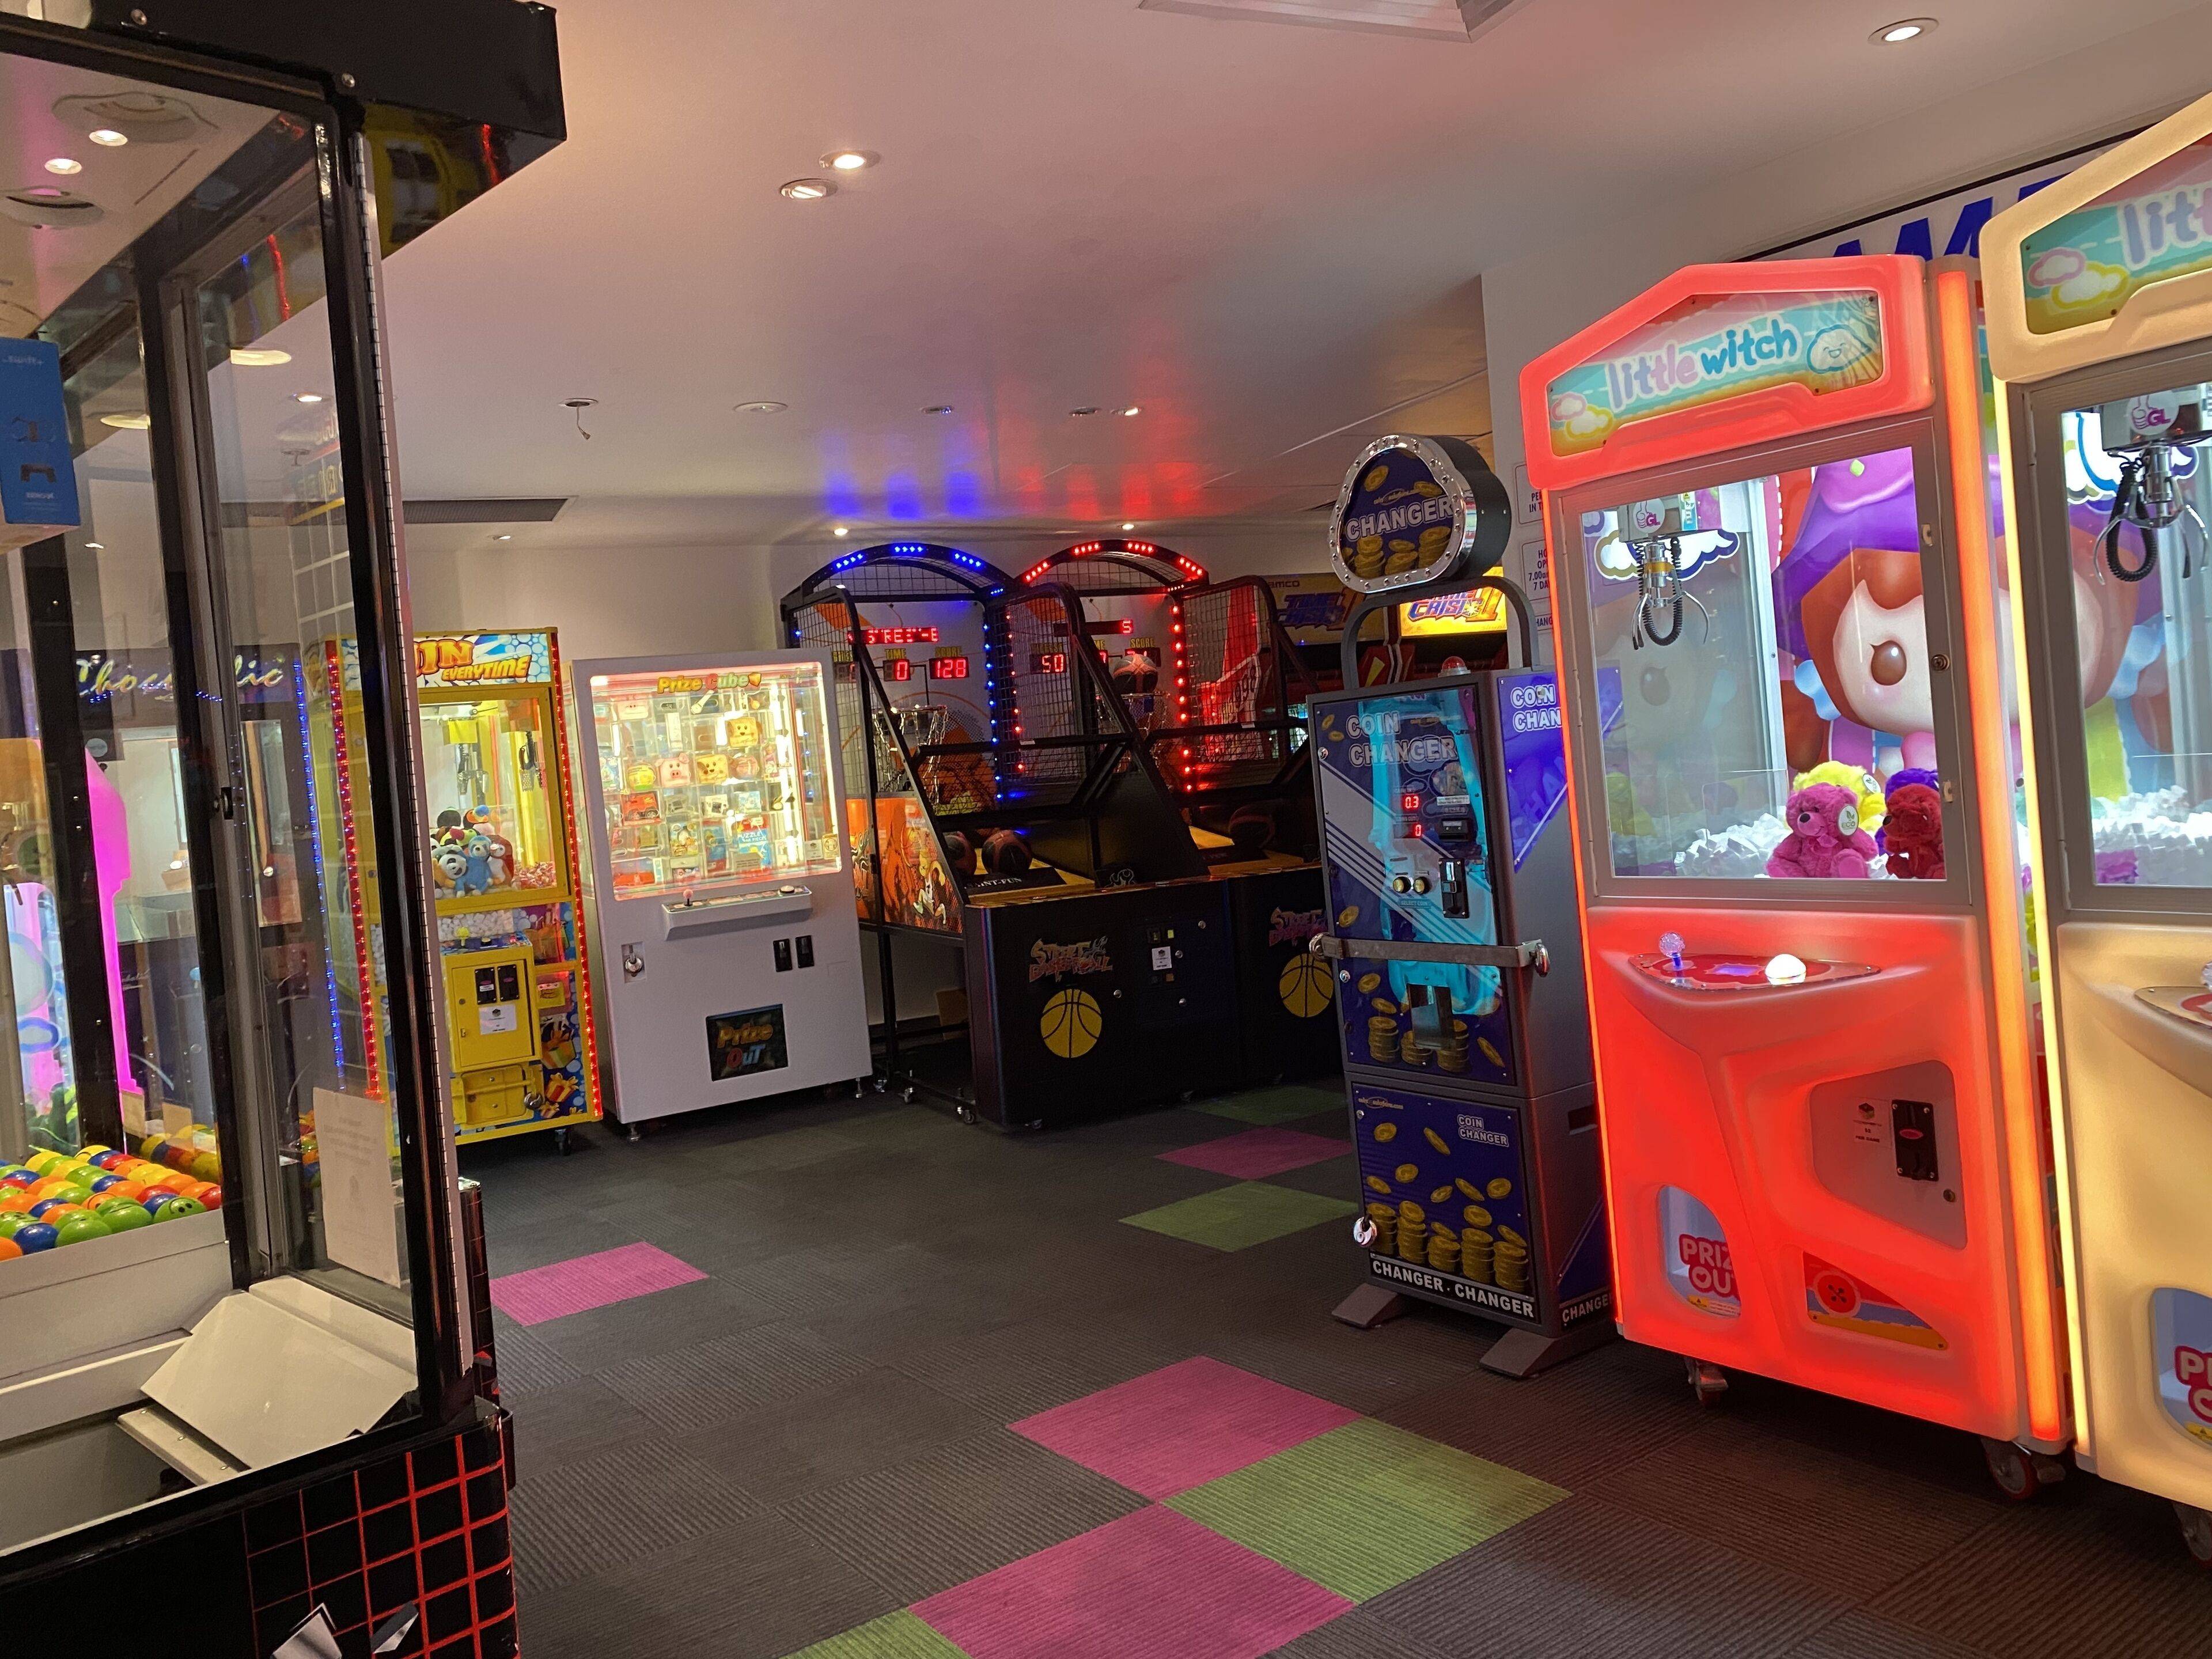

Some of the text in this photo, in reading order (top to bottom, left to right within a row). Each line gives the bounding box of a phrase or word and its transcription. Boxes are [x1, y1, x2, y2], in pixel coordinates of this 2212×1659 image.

[1608, 319, 1797, 410] little witch
[1346, 495, 1453, 541] CHANGER
[1529, 503, 1536, 513] IN
[1533, 582, 1537, 590] 7
[1130, 638, 1155, 647] SCORE
[414, 639, 475, 677] IN
[885, 649, 906, 660] TIME
[1041, 654, 1065, 673] 50
[441, 655, 532, 681] EVERYTIME
[937, 659, 966, 678] 128
[657, 672, 749, 694] Prize Cube
[1346, 711, 1401, 738] COIN
[1349, 736, 1459, 767] CHANGER
[1415, 824, 1422, 837] 0
[1842, 820, 1855, 828] ECO
[1031, 938, 1092, 964] STREET
[717, 1022, 774, 1048] Prize
[1458, 1115, 1484, 1128] COIN
[1459, 1127, 1509, 1146] CHANGER
[1373, 1260, 1535, 1318] CHANGER CHANGER
[1692, 1266, 1734, 1294] OU
